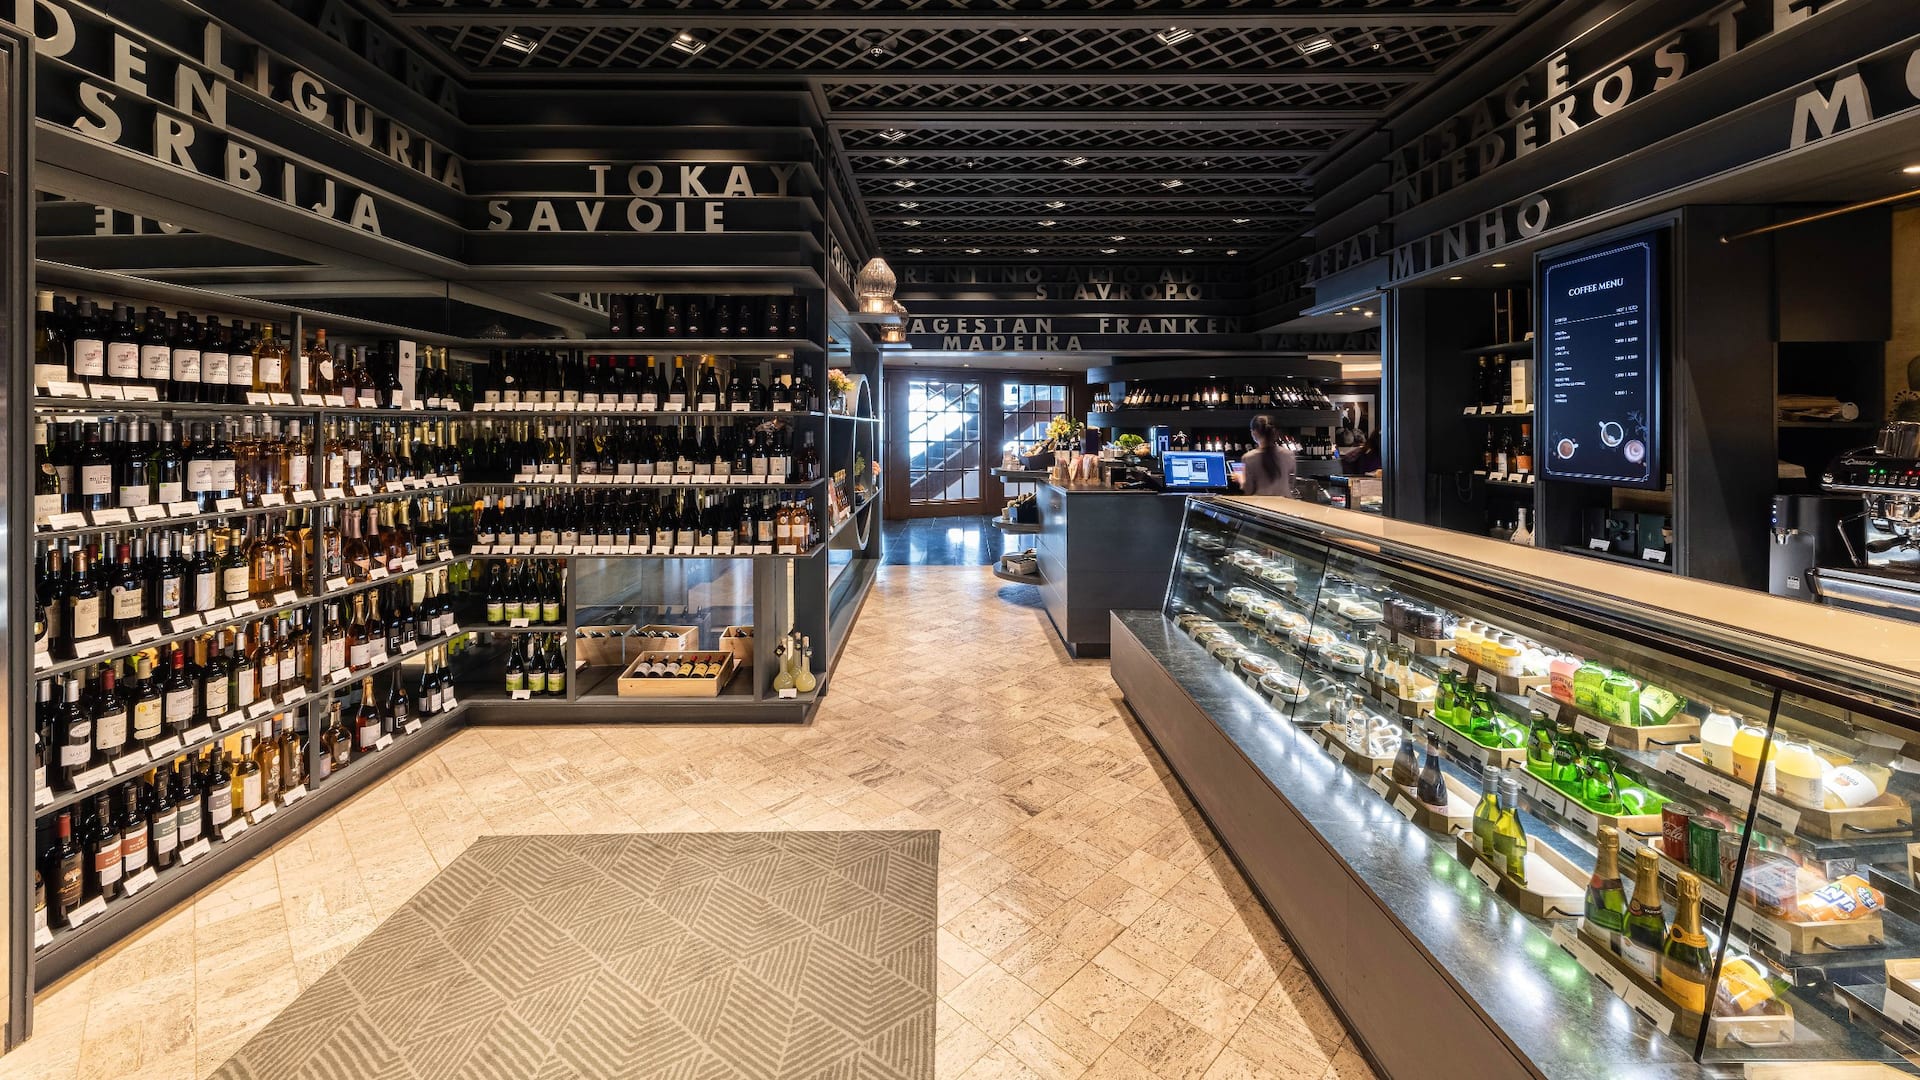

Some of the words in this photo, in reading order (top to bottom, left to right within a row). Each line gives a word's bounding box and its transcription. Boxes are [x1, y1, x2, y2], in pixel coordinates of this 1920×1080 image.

[204, 21, 467, 194] LIGURIA
[1391, 51, 1570, 184] ALSACE
[76, 80, 382, 236] SRBIJA
[588, 164, 797, 198] TOKAY
[487, 198, 725, 233] SAVOIE
[1393, 194, 1551, 281] MINHO
[1036, 284, 1218, 300] STAVROPOL
[1568, 283, 1598, 297] COFFEE
[1599, 278, 1624, 291] MENU
[910, 318, 1053, 334] AGESTAN
[1099, 318, 1241, 334] FRANKEN
[942, 336, 1083, 351] MADEIRA
